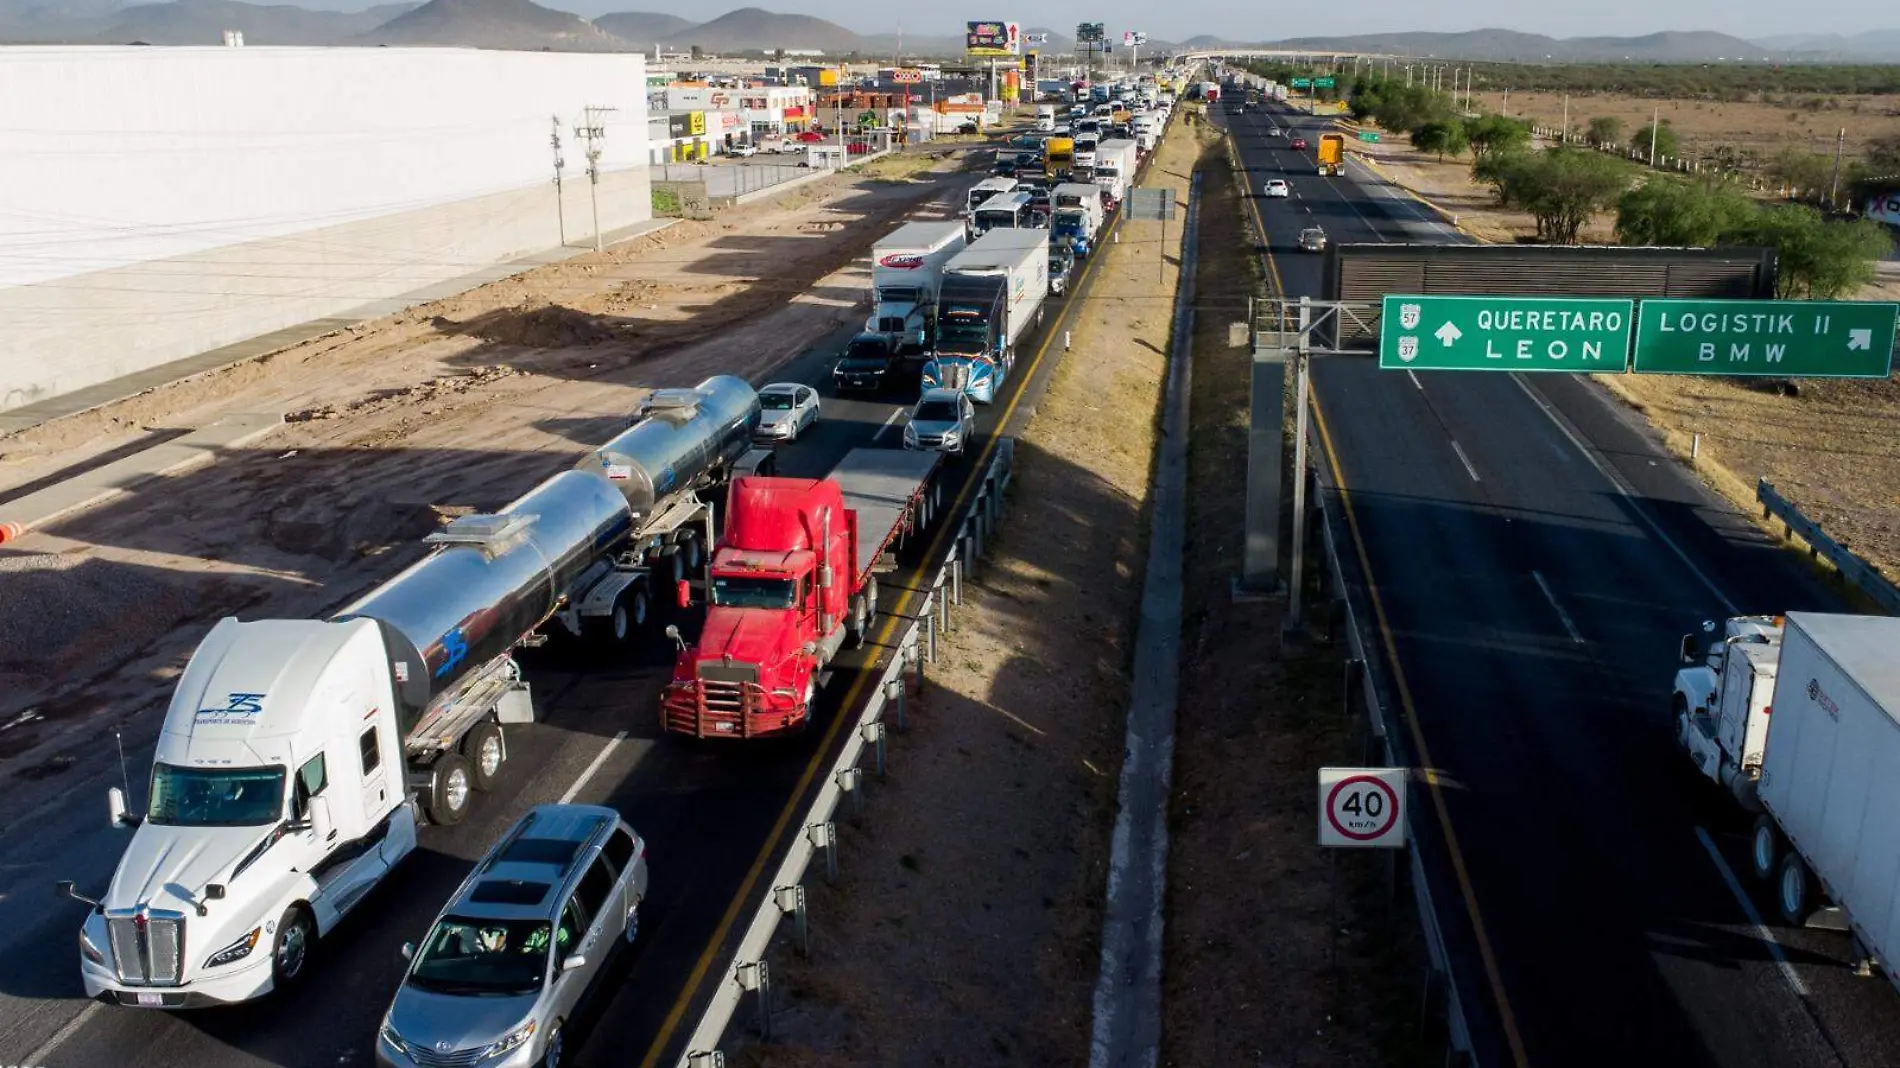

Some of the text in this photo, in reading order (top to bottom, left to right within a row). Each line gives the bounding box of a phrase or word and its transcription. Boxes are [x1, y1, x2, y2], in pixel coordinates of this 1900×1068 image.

[1403, 312, 1416, 324] 57
[1477, 310, 1622, 331] QUERETARO
[1660, 312, 1831, 334] LOGISTIK II
[1401, 344, 1415, 356] 37
[1486, 340, 1602, 360] LEON
[1699, 342, 1786, 363] BMW
[1342, 791, 1382, 817] 40
[1348, 820, 1376, 829] km/h
